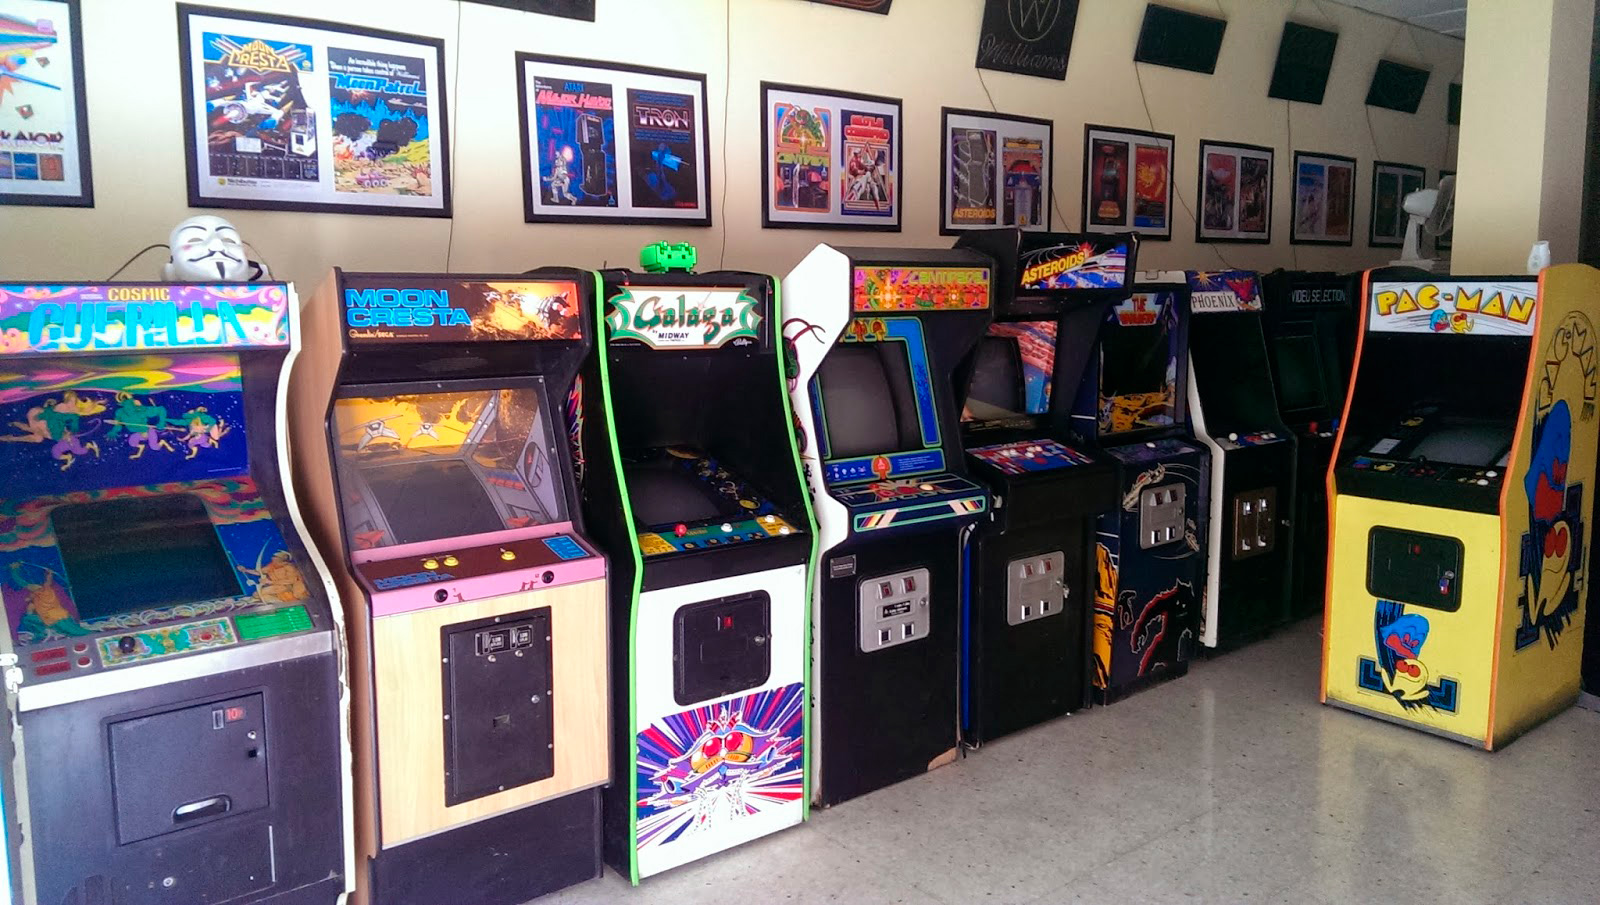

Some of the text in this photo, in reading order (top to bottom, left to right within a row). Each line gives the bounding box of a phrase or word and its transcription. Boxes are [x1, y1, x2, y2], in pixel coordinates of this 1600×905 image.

[228, 49, 291, 71] CRESTA
[980, 33, 1066, 72] Williams
[333, 73, 375, 91] Moon
[635, 106, 689, 129] TRON
[953, 207, 996, 219] ASTEROIDS
[1020, 251, 1085, 285] ASTEROIDS
[107, 287, 170, 301] COSMIC
[345, 288, 449, 308] MOON
[1132, 295, 1147, 312] THE
[1191, 292, 1237, 309] PHOENIX
[1291, 289, 1346, 303] VIDEO SELECTION
[1375, 284, 1536, 325] PAC-MAN
[346, 307, 473, 327] CRESTA
[633, 294, 737, 347] Galaga
